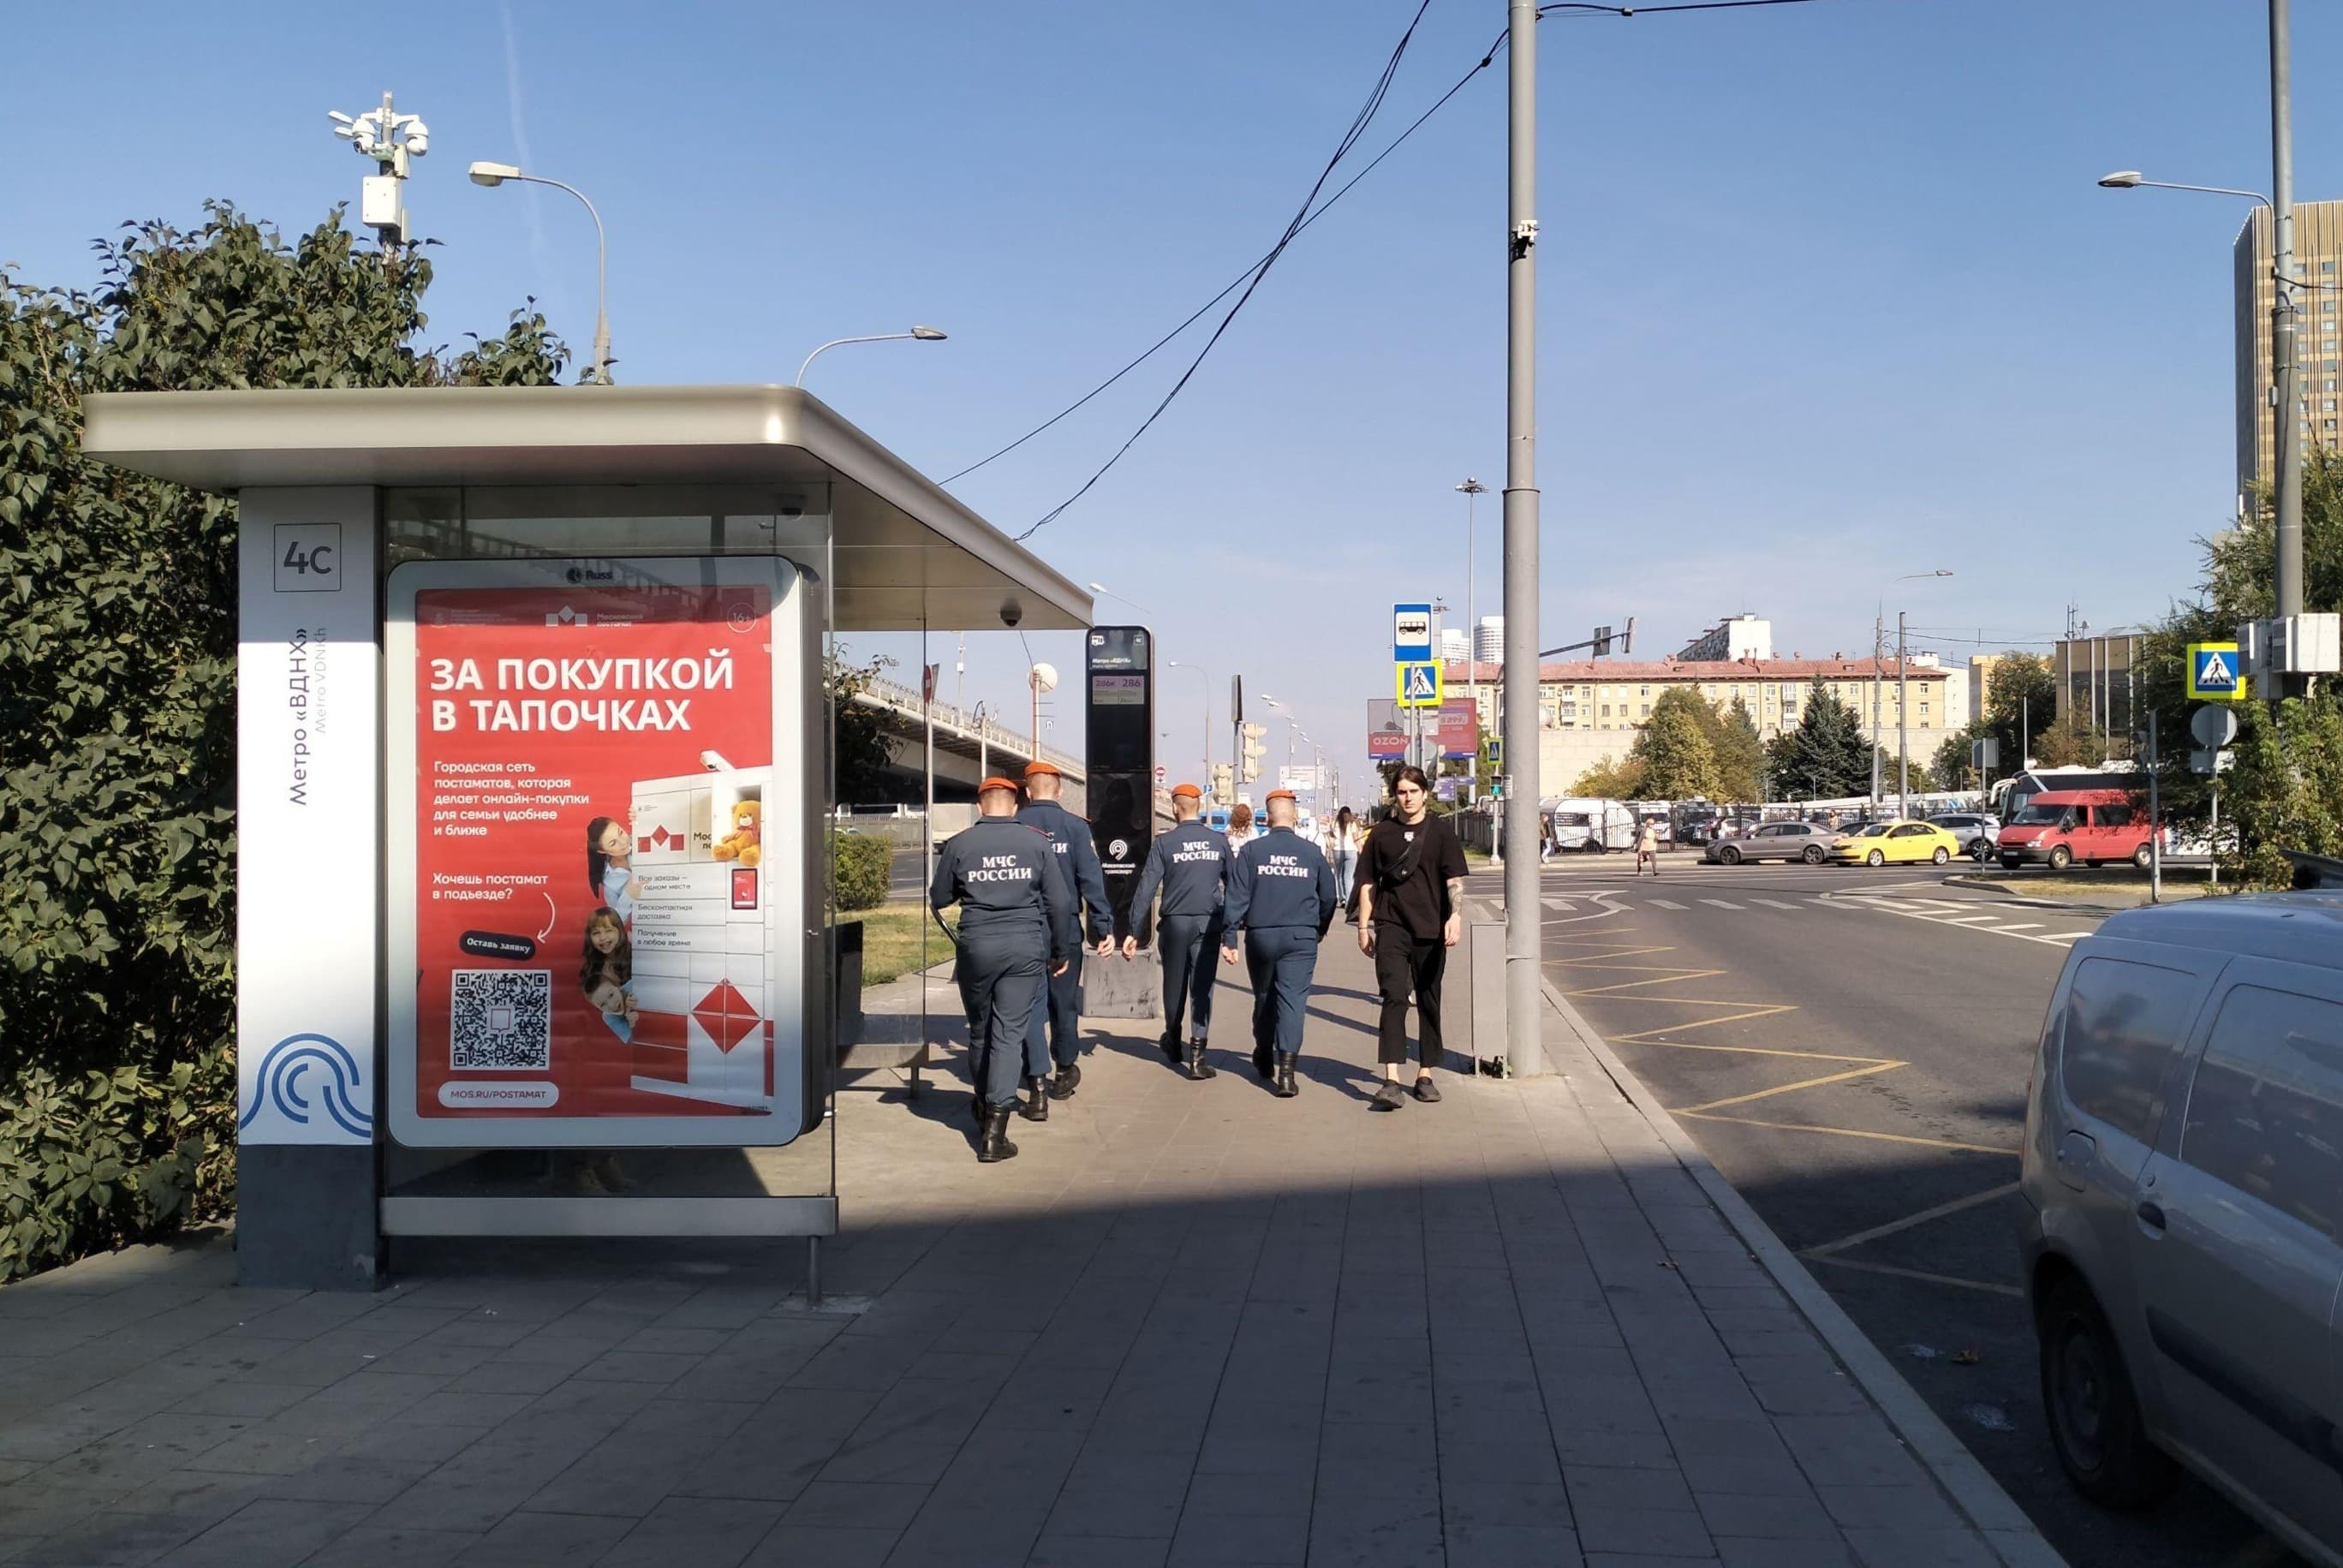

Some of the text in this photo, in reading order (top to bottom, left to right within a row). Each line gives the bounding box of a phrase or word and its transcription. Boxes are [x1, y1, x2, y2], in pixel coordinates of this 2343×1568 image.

[430, 648, 734, 691] ЗА ПОКУПКОЙ
[289, 628, 311, 806] Метро «ВДНХ»
[432, 700, 692, 731] В ТАПОЧКАХ
[433, 761, 536, 774] Городская сеть
[434, 778, 571, 790] постаматов, которая
[433, 792, 590, 806] делает онлайн-покупки
[433, 808, 558, 822] для семьи удобнее
[434, 824, 488, 836] и ближе
[1182, 841, 1211, 852] МЧС
[982, 855, 1017, 869] МЧС
[1172, 850, 1220, 864] РОССИИ
[1269, 855, 1298, 866] МЧС
[432, 872, 549, 885] Хочешь постамат
[968, 867, 1033, 883] РОССИИ
[1257, 865, 1309, 879] РОССИИ
[432, 891, 440, 899] в
[466, 937, 531, 955] Оставь заявку
[450, 1090, 547, 1099] MOS.RU/POSTAMAT
